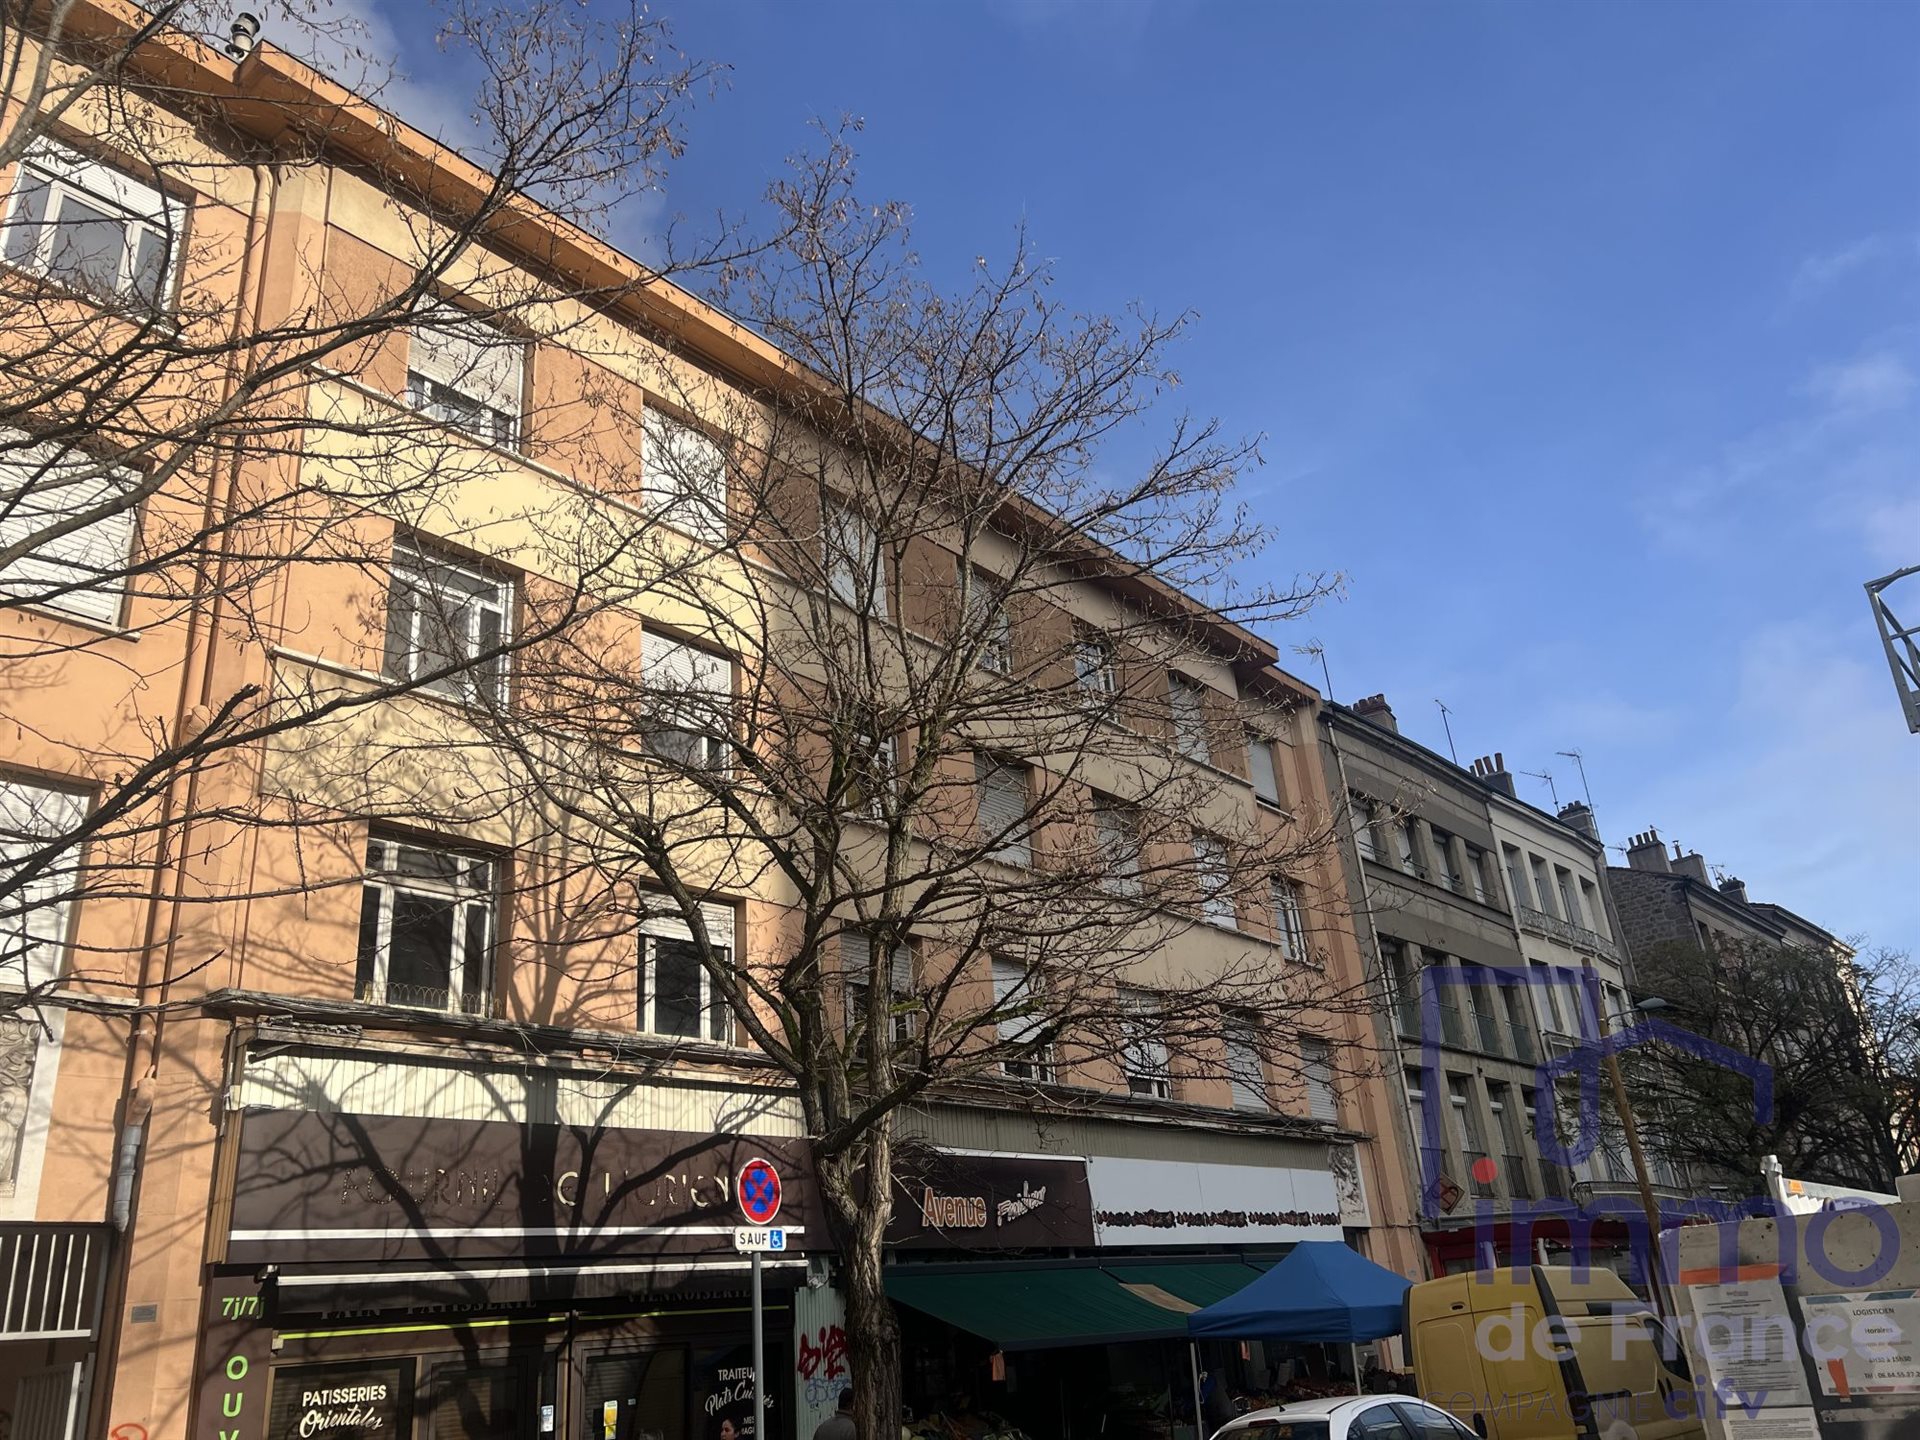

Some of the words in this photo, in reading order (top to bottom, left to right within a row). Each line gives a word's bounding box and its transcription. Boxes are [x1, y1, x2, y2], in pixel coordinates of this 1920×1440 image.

[341, 1167, 503, 1207] FOURNIL
[922, 1186, 987, 1228] Avenue
[739, 1230, 768, 1247] SAUF
[222, 1296, 266, 1320] 7j/7j
[1852, 1307, 1895, 1316] LOGISTICIEN
[301, 1384, 387, 1407] PATISSERIES
[704, 1386, 733, 1417] Plats
[298, 1403, 384, 1439] Orientales
